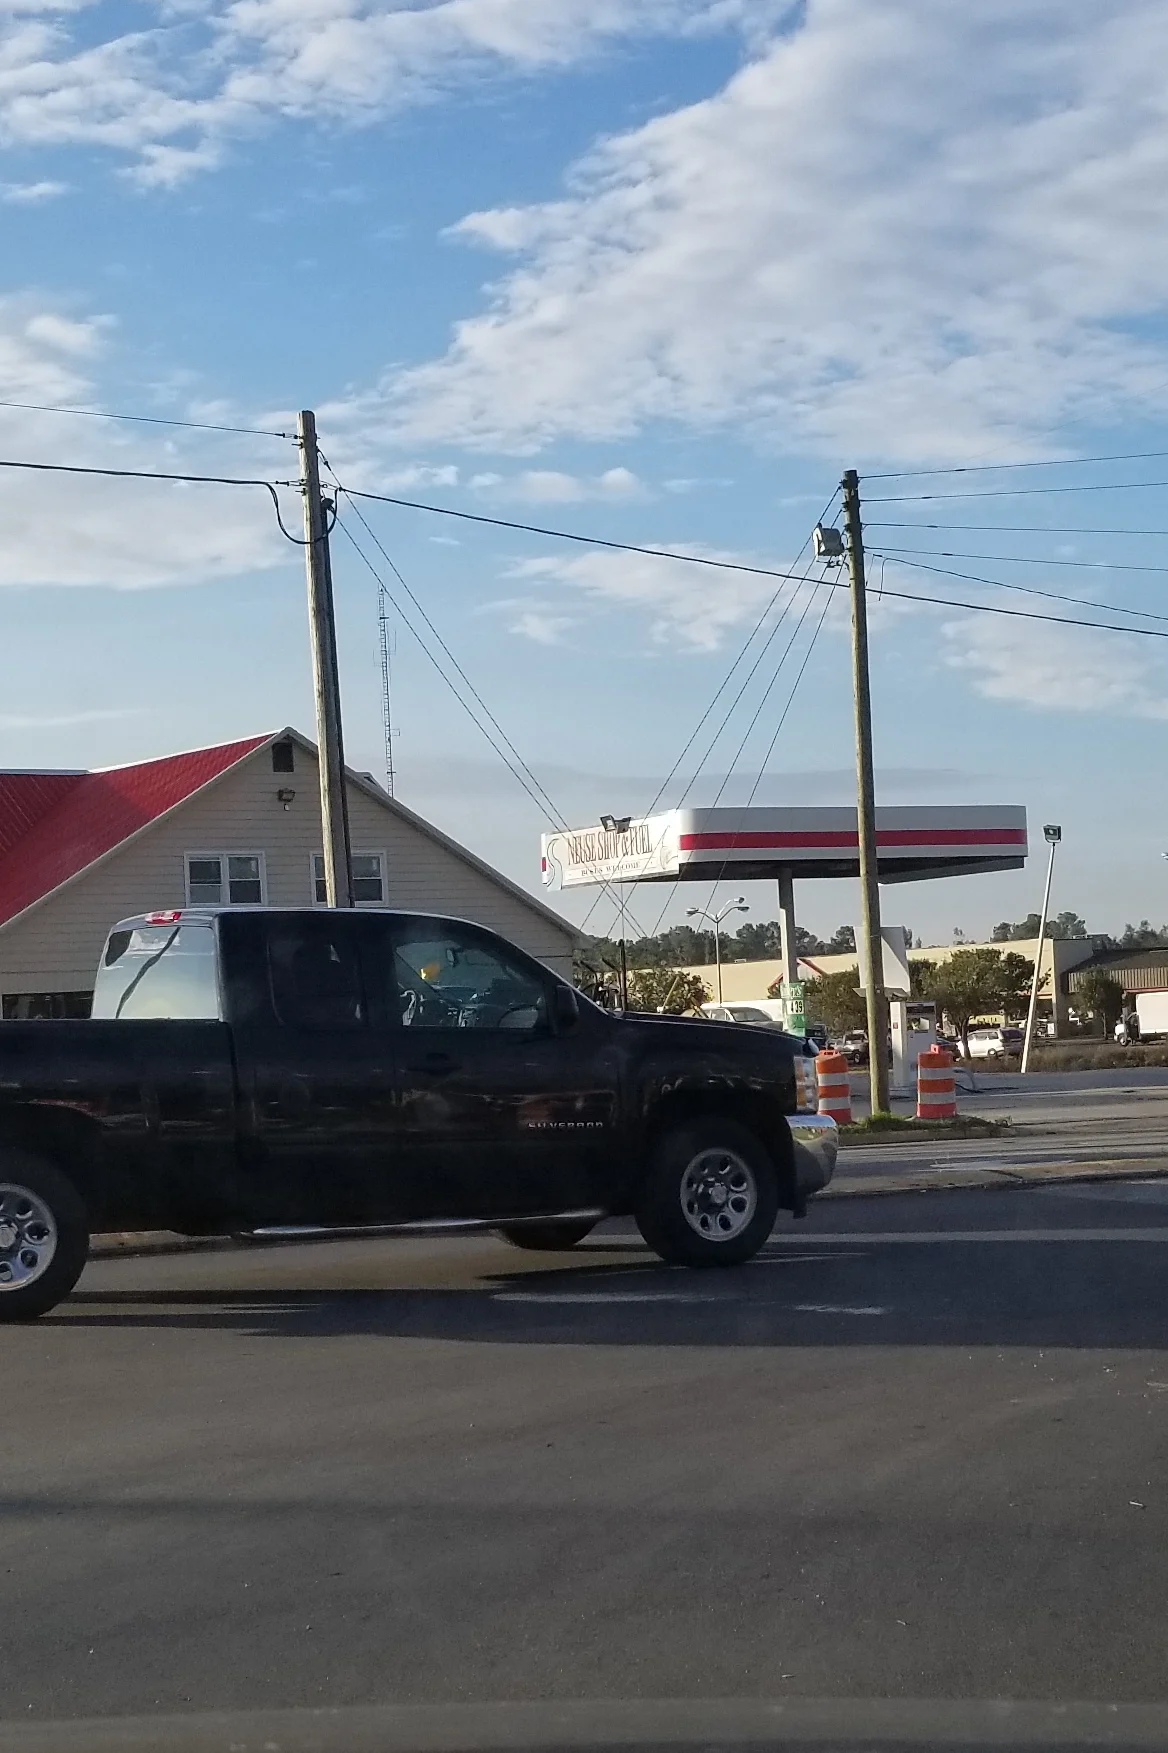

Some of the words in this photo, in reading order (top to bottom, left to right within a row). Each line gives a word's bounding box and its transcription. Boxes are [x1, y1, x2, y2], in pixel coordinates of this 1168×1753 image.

[567, 833, 596, 865] NEUSE
[598, 831, 620, 860] SHOP
[622, 834, 629, 856] &
[628, 825, 653, 855] FUEL
[606, 861, 640, 872] WELCOME
